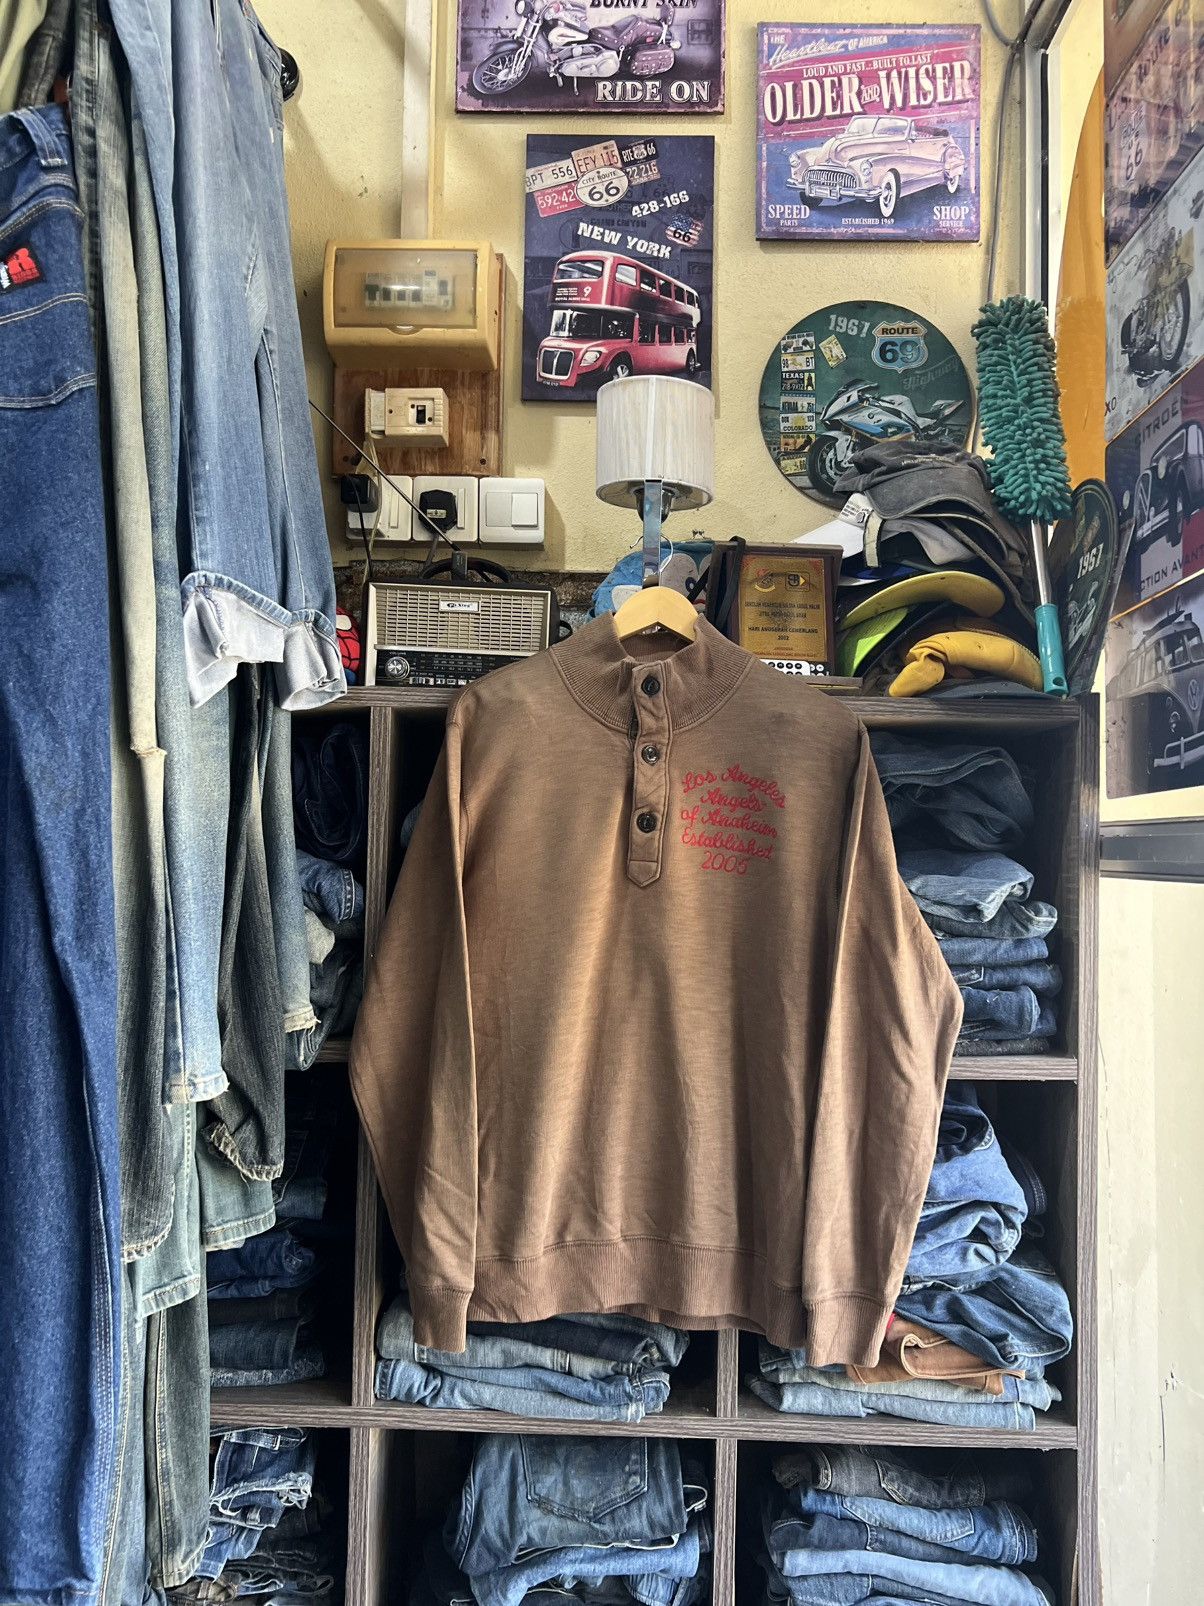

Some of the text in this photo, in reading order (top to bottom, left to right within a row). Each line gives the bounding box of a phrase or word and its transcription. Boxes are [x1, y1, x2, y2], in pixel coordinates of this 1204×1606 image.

[803, 66, 826, 78] LOUD
[827, 64, 845, 75] AND
[899, 56, 911, 66] TO
[911, 53, 932, 65] LAST
[595, 79, 711, 102] RIDE ON
[763, 59, 974, 124] OLDER AND WISER
[551, 165, 573, 180] 556
[581, 171, 617, 185] CITY ROUTE
[588, 181, 621, 202] 66
[631, 190, 690, 218] 428-166
[768, 204, 810, 219] SPEED
[933, 205, 970, 220] SHOP
[780, 219, 798, 227] PARTS
[841, 217, 880, 225] ESTABLISHED
[939, 220, 964, 228] SERVICE
[577, 221, 673, 260] NEW YORK
[673, 228, 692, 243] 66
[583, 285, 593, 298] 9
[828, 314, 871, 338] 1967
[881, 327, 918, 336] ROUTE
[879, 340, 921, 364] 69
[682, 763, 786, 809] Los Angeles
[700, 787, 767, 813] Angels
[681, 805, 778, 839] of Anaheim
[701, 851, 748, 876] 2005
